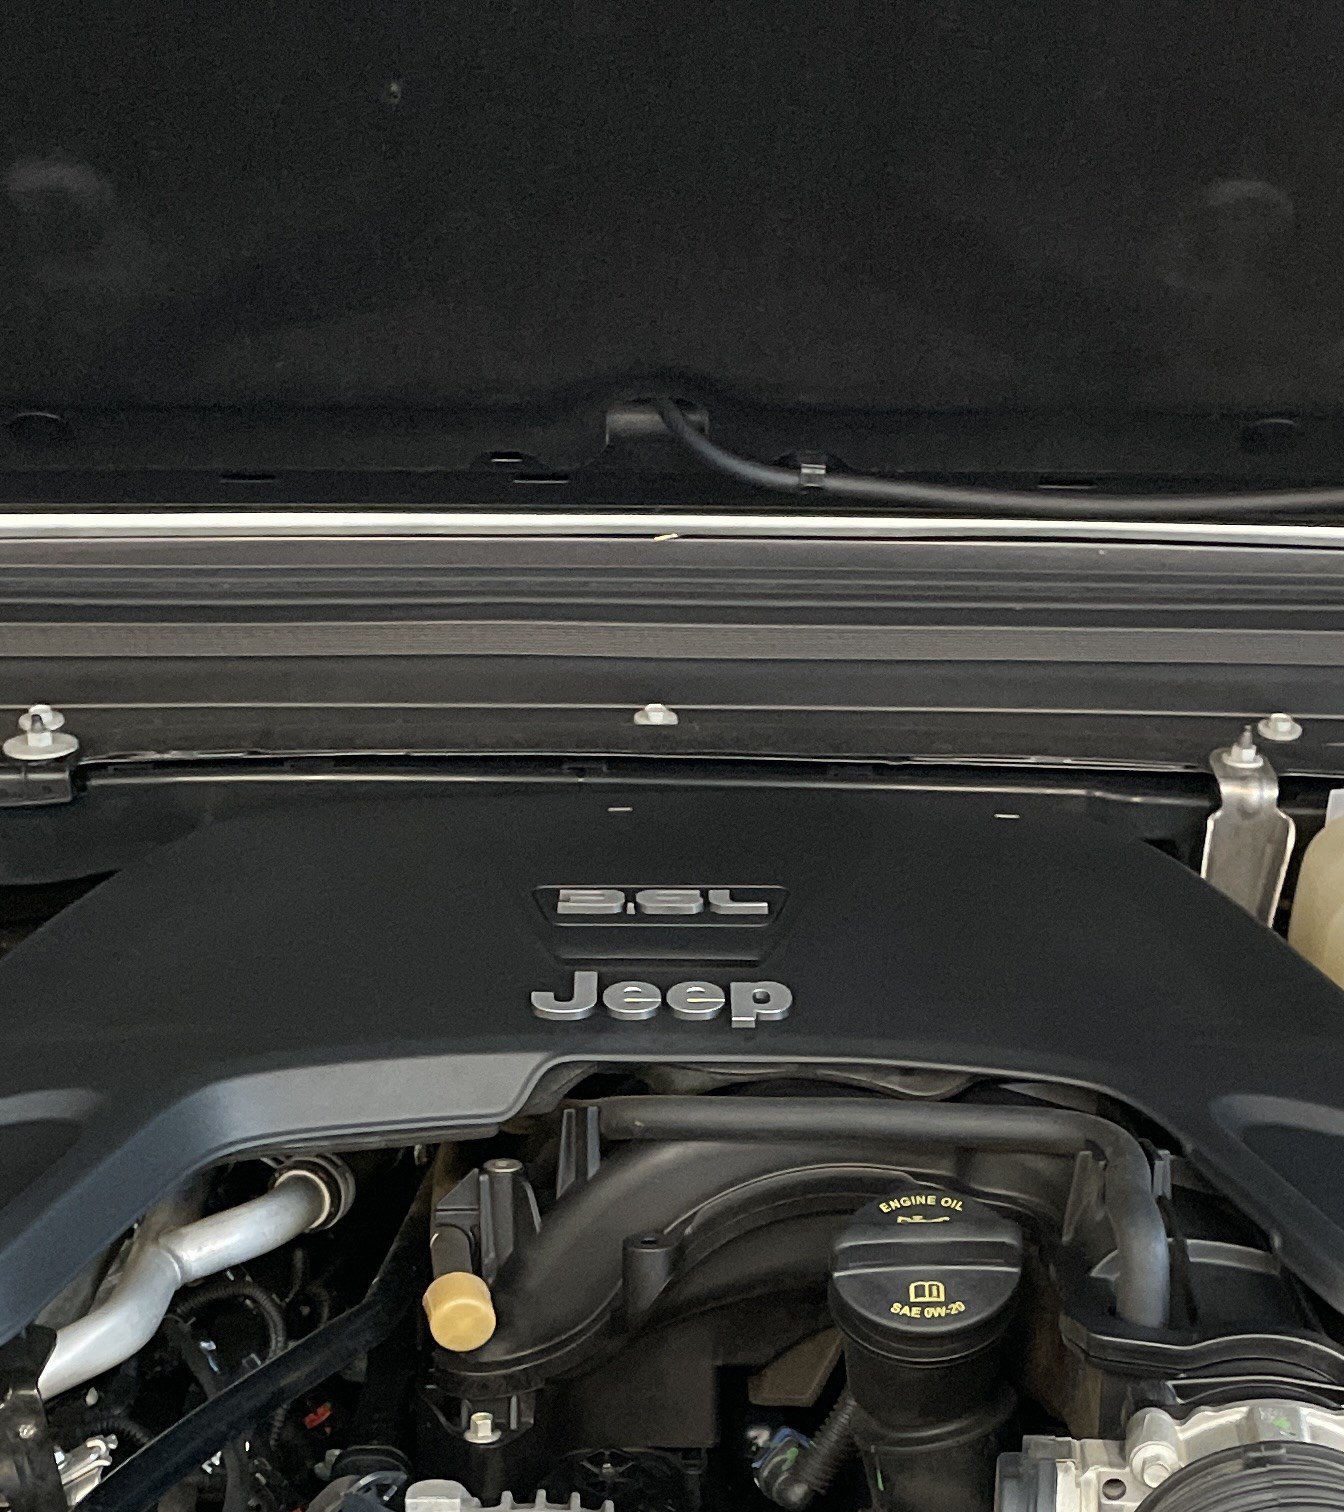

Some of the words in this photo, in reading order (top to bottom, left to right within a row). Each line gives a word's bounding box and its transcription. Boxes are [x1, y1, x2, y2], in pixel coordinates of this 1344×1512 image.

[557, 889, 768, 915] 3.6L
[531, 971, 793, 1028] Jeep
[879, 1195, 937, 1213] ENGINE
[940, 1197, 963, 1212] OIL
[890, 1302, 922, 1319] SAE
[923, 1301, 966, 1319] 0W-20
